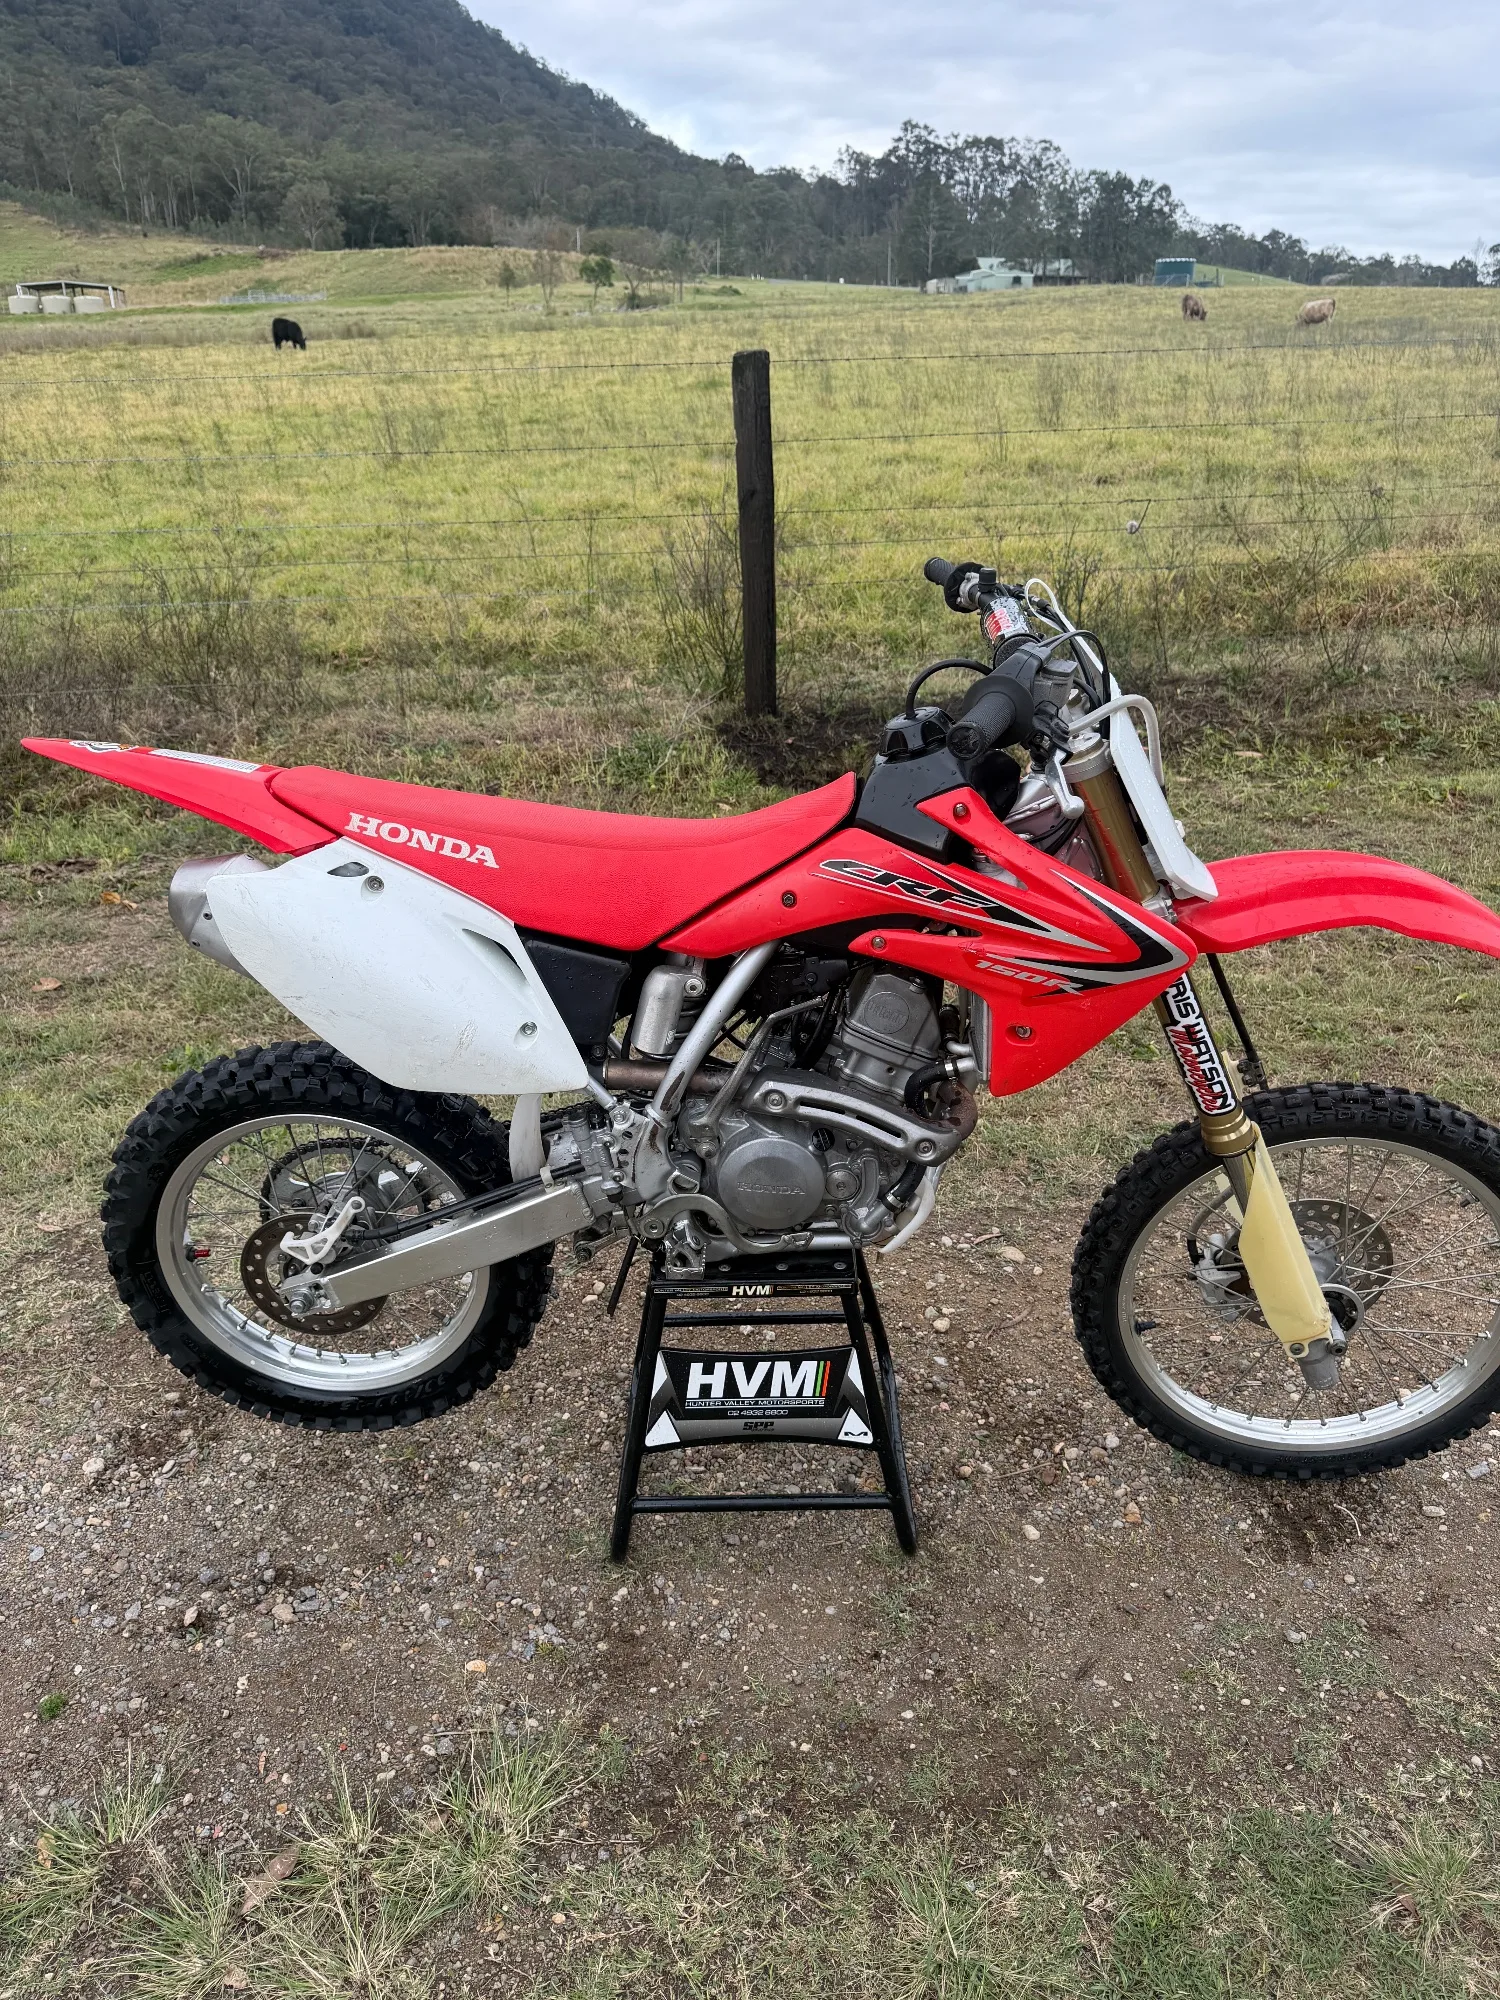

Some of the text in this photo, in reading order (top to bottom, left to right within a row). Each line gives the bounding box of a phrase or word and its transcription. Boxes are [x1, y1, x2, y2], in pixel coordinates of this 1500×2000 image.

[345, 812, 499, 868] HONDA
[820, 859, 1000, 909] CRF
[975, 960, 1084, 996] 150R
[1169, 976, 1232, 1109] RIS WATSON
[737, 1182, 806, 1195] HONDA
[731, 1285, 770, 1297] HVM
[686, 1360, 818, 1398] HVM
[743, 1421, 774, 1430] SPP
